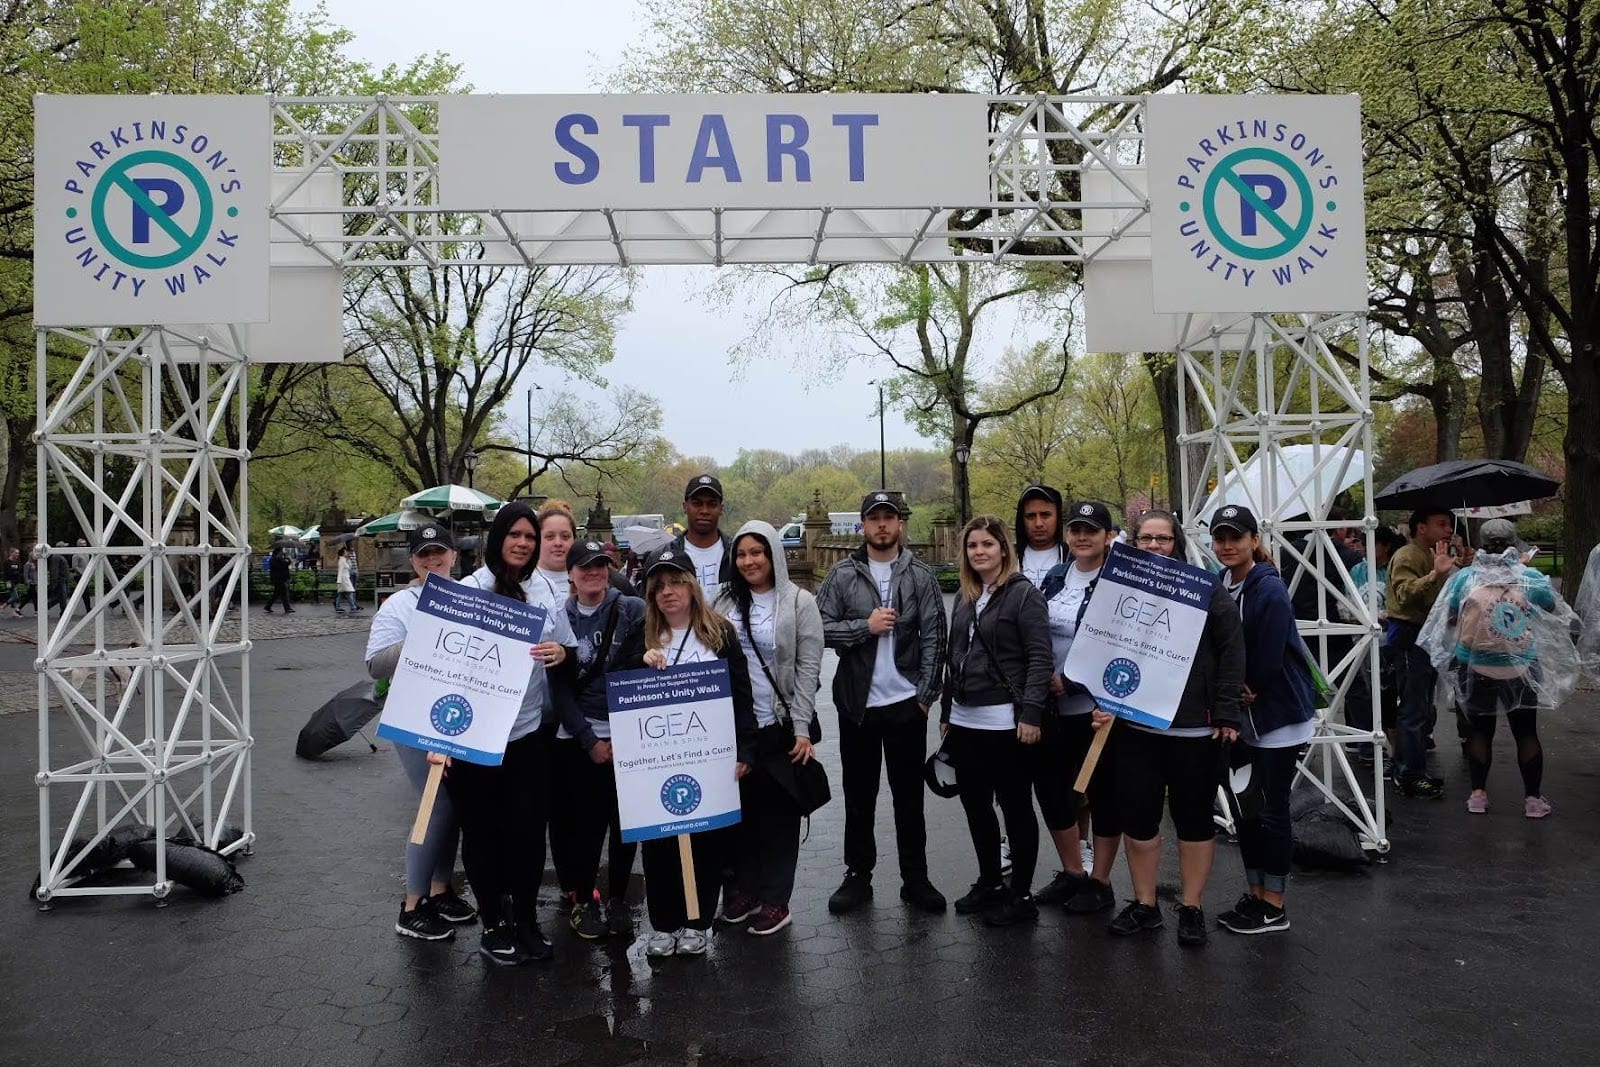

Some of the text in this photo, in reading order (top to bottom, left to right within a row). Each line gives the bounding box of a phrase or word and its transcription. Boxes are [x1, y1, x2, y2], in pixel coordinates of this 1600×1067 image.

[64, 120, 240, 194] PARKINSON'S
[554, 113, 878, 184] START
[1178, 120, 1337, 190] PARKINSON'S
[65, 227, 238, 296] UNITY WALK
[1180, 220, 1338, 286] UNITY WALK
[1151, 561, 1163, 571] Team
[428, 582, 437, 590] The
[475, 596, 489, 605] Team
[509, 607, 522, 615] Brain
[1112, 567, 1202, 602] Parkinson's Unity Walk
[429, 600, 531, 636] Parkinson's Unity Walk
[482, 605, 503, 616] Support
[1114, 594, 1170, 632] IGEA
[435, 628, 501, 668] IGEA
[1119, 635, 1139, 647] Let's
[1140, 642, 1158, 651] Find
[1166, 650, 1190, 662] Cure!
[404, 657, 445, 677] Together,
[447, 670, 468, 681] Let's
[469, 676, 489, 688] Find
[498, 685, 522, 696] Cure!
[619, 684, 720, 704] Parkinson's Unity Walk
[667, 680, 689, 688] Support
[638, 712, 707, 740] IGEA
[618, 757, 660, 768] Together,
[661, 753, 682, 762] Let's
[684, 750, 702, 759] Find
[712, 745, 734, 755] Cure!
[660, 821, 709, 832] IGEAneuro.com
